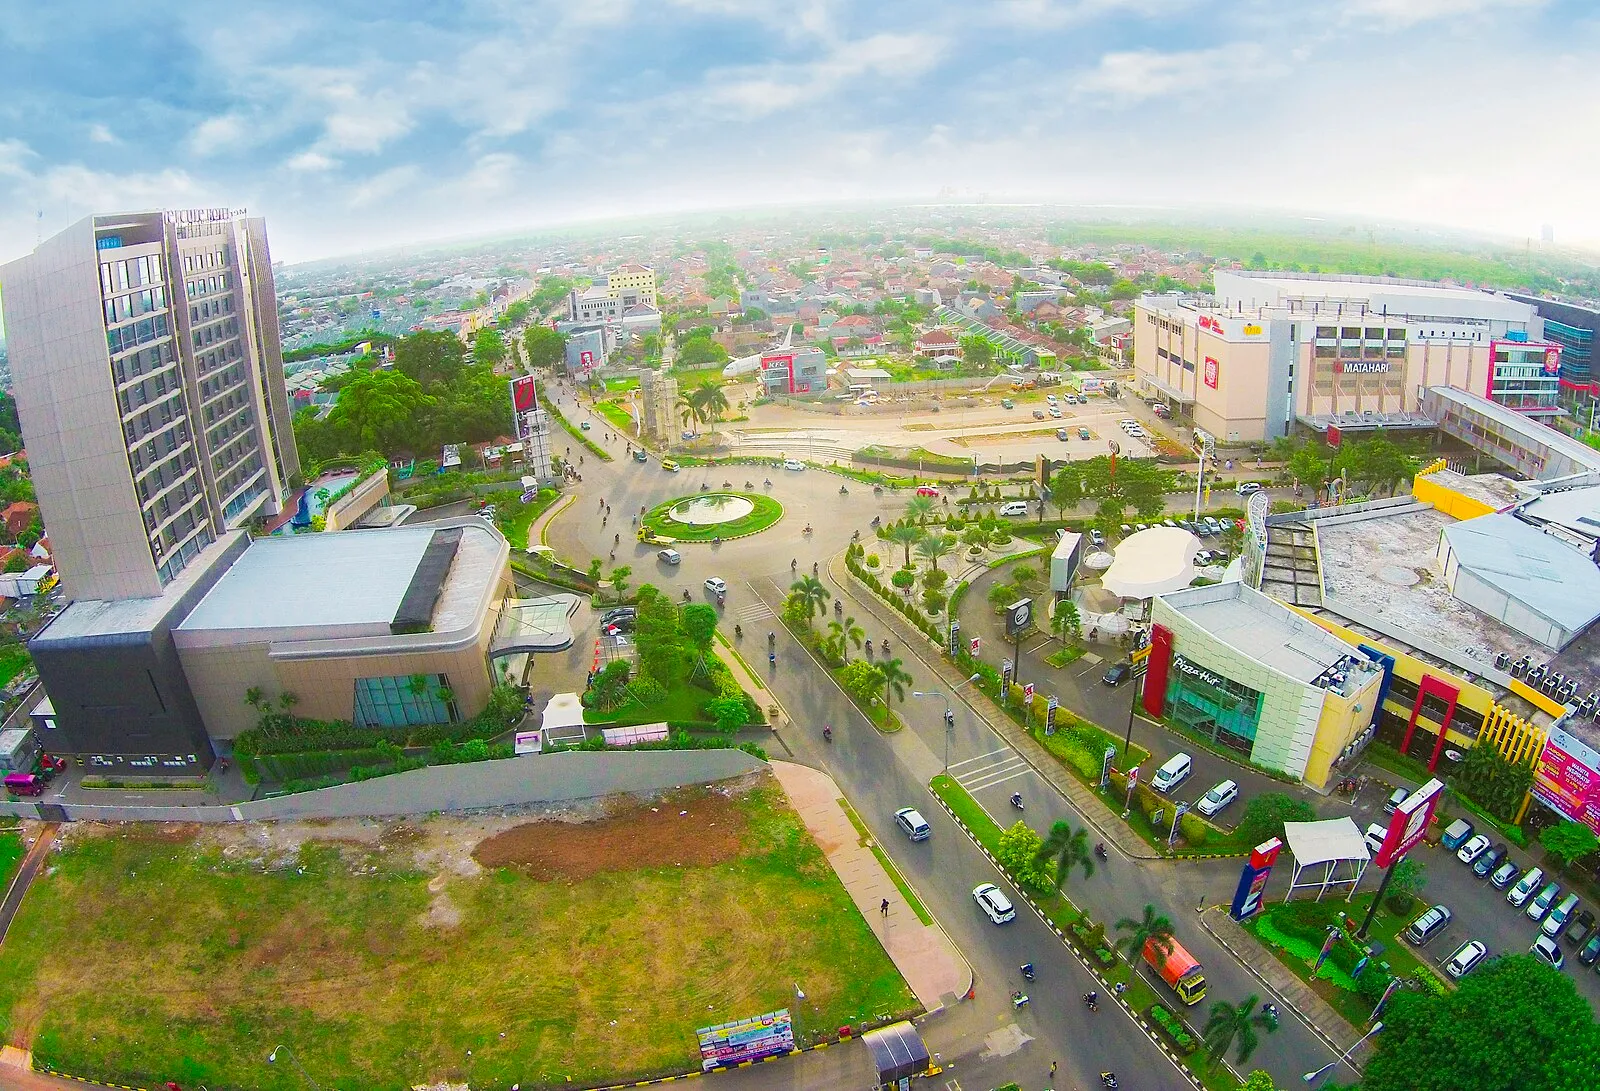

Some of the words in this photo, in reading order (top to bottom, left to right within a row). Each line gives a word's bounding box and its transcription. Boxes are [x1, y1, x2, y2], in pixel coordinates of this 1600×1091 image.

[1344, 363, 1389, 373] MATAHARI
[1173, 657, 1199, 675] Pizza
[1198, 671, 1219, 686] Hut
